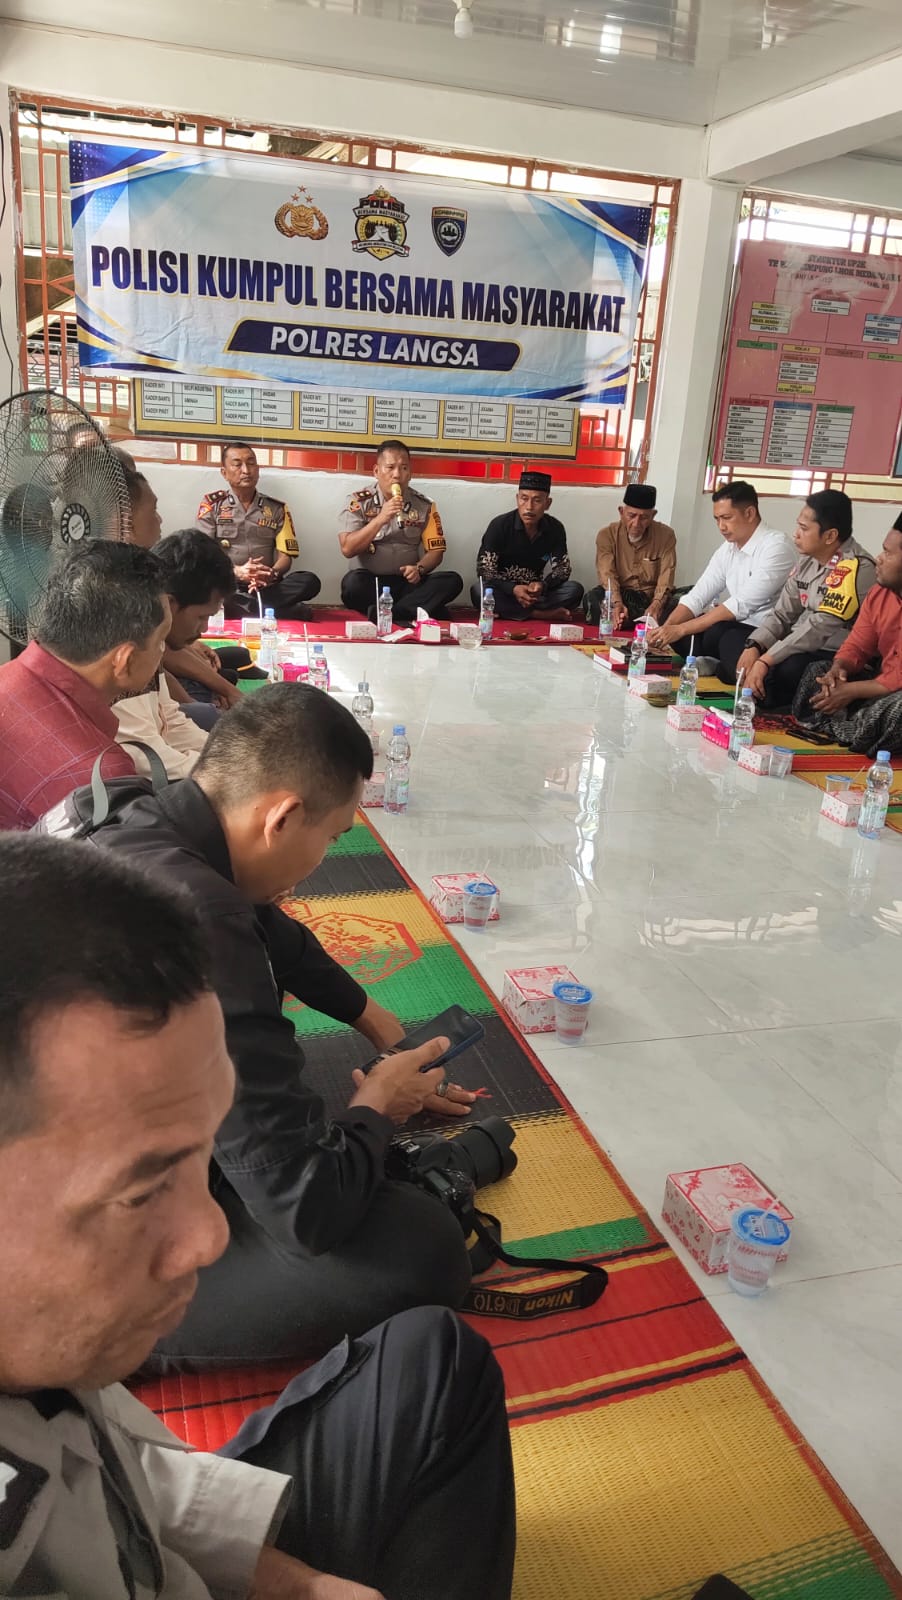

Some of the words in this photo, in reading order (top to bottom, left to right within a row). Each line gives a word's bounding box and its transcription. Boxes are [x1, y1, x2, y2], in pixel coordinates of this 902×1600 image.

[359, 198, 406, 214] POLISI
[91, 245, 189, 295] POLISI
[197, 254, 318, 307] KUMPUL
[325, 267, 455, 320] BERSAMA
[462, 281, 626, 334] MASYARAKAT
[271, 326, 374, 361] POLRES
[378, 335, 479, 367] LANGSA
[474, 1294, 520, 1316] D610
[524, 1290, 574, 1312] Nikon
